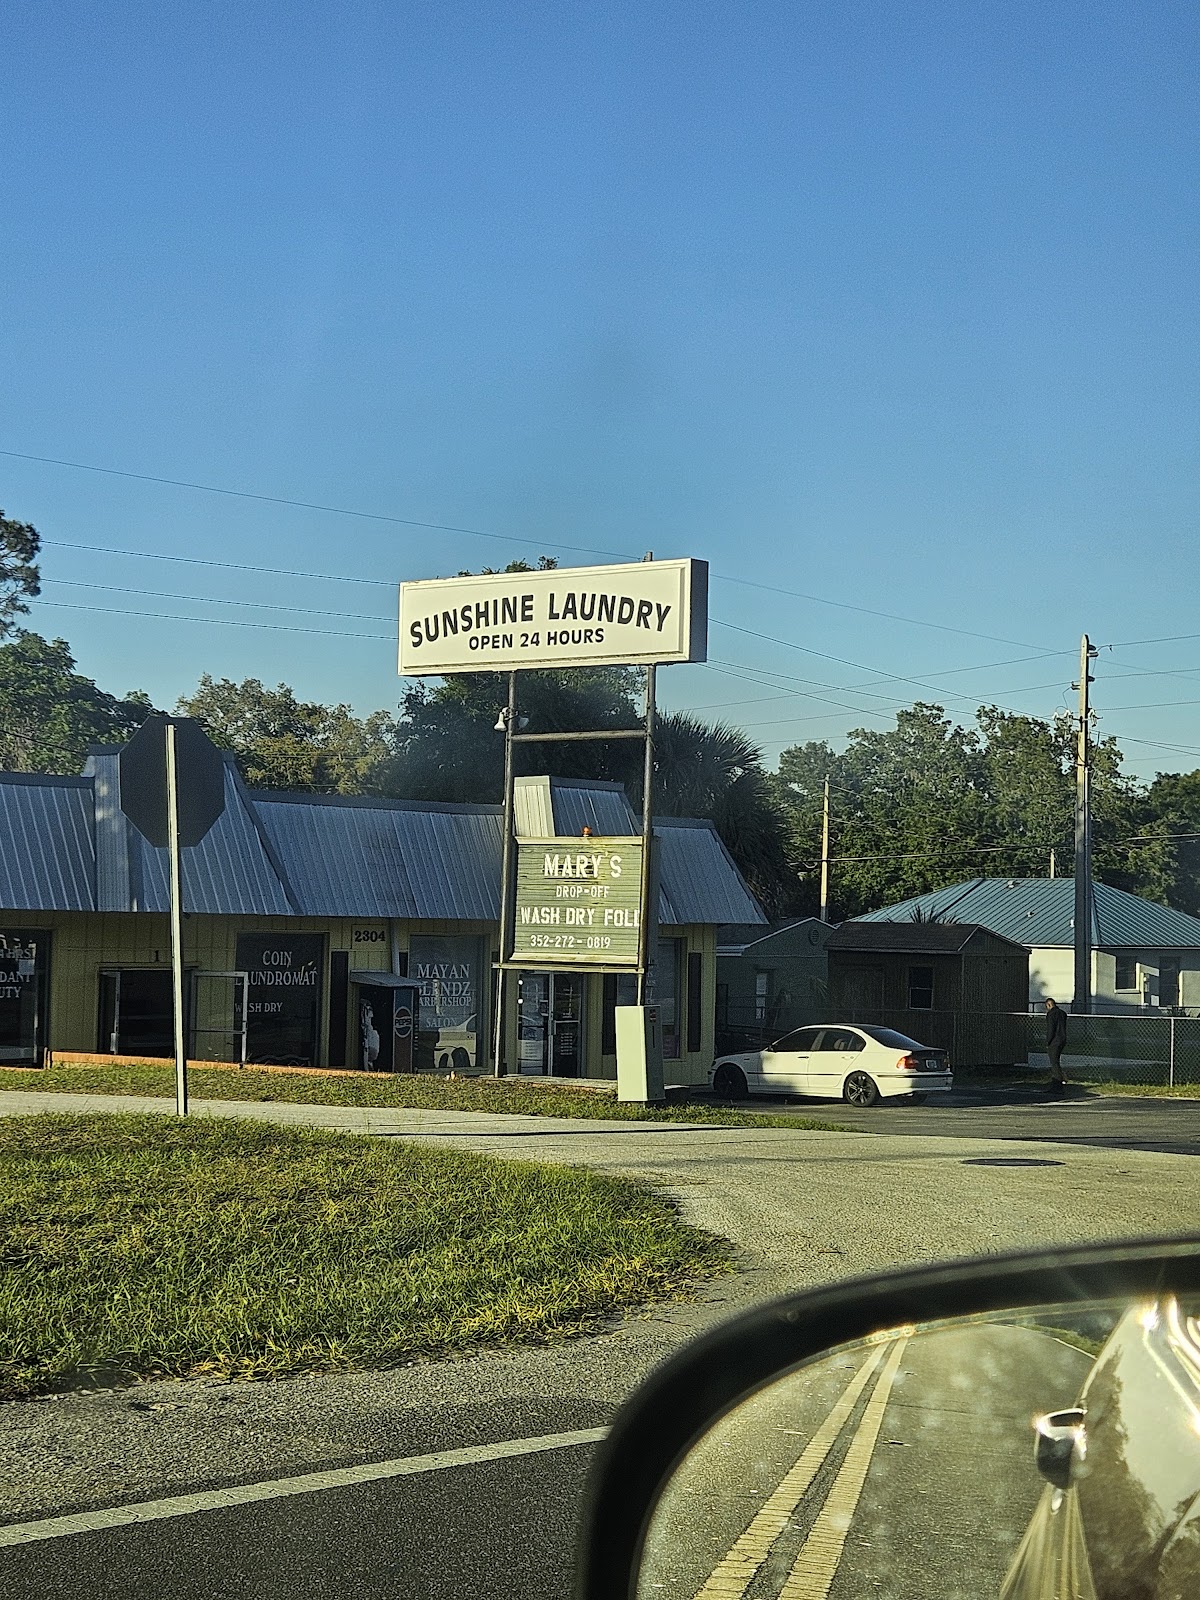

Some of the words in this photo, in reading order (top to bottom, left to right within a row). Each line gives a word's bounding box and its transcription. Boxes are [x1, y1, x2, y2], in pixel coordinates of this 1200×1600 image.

[410, 594, 535, 648] SUNSHINE
[548, 592, 672, 633] LAUNDRY
[468, 633, 513, 651] OPEN
[520, 632, 541, 648] 24
[547, 628, 605, 646] HOURS
[543, 851, 623, 878] MARY'S
[556, 885, 610, 898] DROP-OFF
[520, 907, 560, 925] WASH
[566, 907, 595, 925] DRY
[354, 930, 386, 942] 2304
[153, 950, 160, 962] 1
[262, 950, 292, 966] COIN
[417, 964, 470, 979] MAYAN
[418, 981, 471, 996] LNDZ
[234, 1002, 262, 1013] WSH
[264, 1002, 283, 1013] DRY
